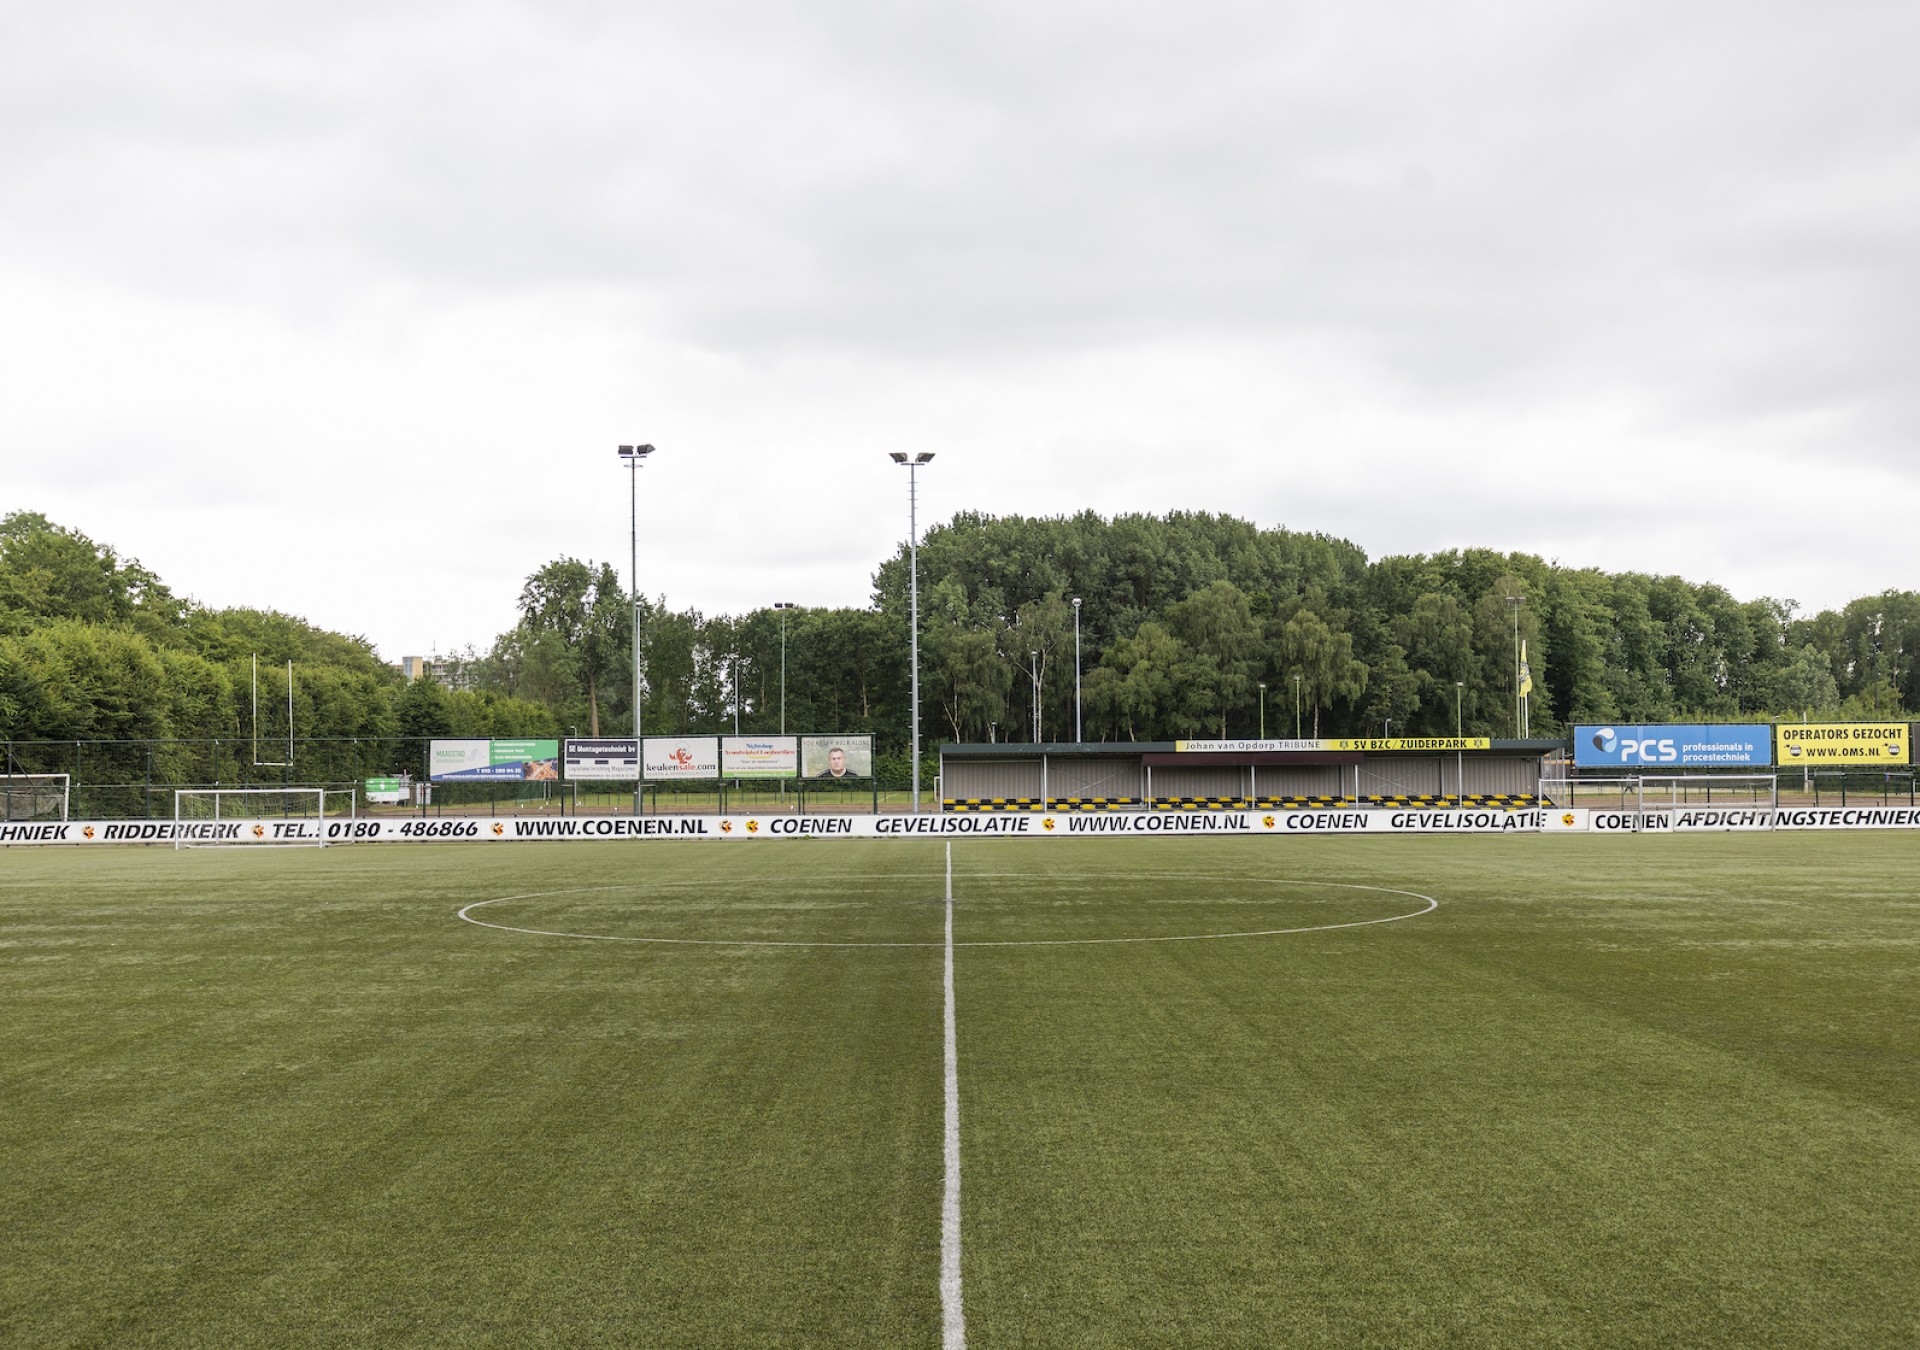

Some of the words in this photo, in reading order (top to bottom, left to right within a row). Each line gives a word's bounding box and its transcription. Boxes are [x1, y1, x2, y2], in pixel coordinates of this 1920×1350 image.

[1783, 728, 1849, 740] OPERATORS
[1853, 728, 1903, 739] GEZOCHT
[577, 744, 627, 754] Montagetechniek
[627, 744, 636, 753] bv
[1185, 741, 1215, 750] Johan
[1238, 741, 1275, 751] Opdorp
[1278, 740, 1321, 749] TRIBUNE
[1353, 739, 1367, 749] SV
[1620, 739, 1678, 762] PCS
[1682, 742, 1742, 752] professionals
[1744, 742, 1753, 751] in
[435, 750, 465, 758] MAASSTAD
[1682, 752, 1751, 762] procestechniek
[1806, 747, 1881, 757] WWW.OMS.NL
[646, 762, 716, 771] keukensale.com
[770, 818, 852, 833] COENEN
[875, 817, 1030, 832] GEVELISOLATIE
[1068, 814, 1250, 831] WWW.COENEN.NL
[1286, 813, 1368, 829] COENEN
[1391, 810, 1547, 830] GEVELISOLATIE
[1595, 814, 1669, 829] COENEN
[0, 825, 70, 840] HNIEK
[103, 823, 242, 840] RIDDERKERK
[327, 822, 381, 838] 0180
[400, 821, 479, 837] 486866
[515, 819, 708, 836] WWW.COENEN.NL
